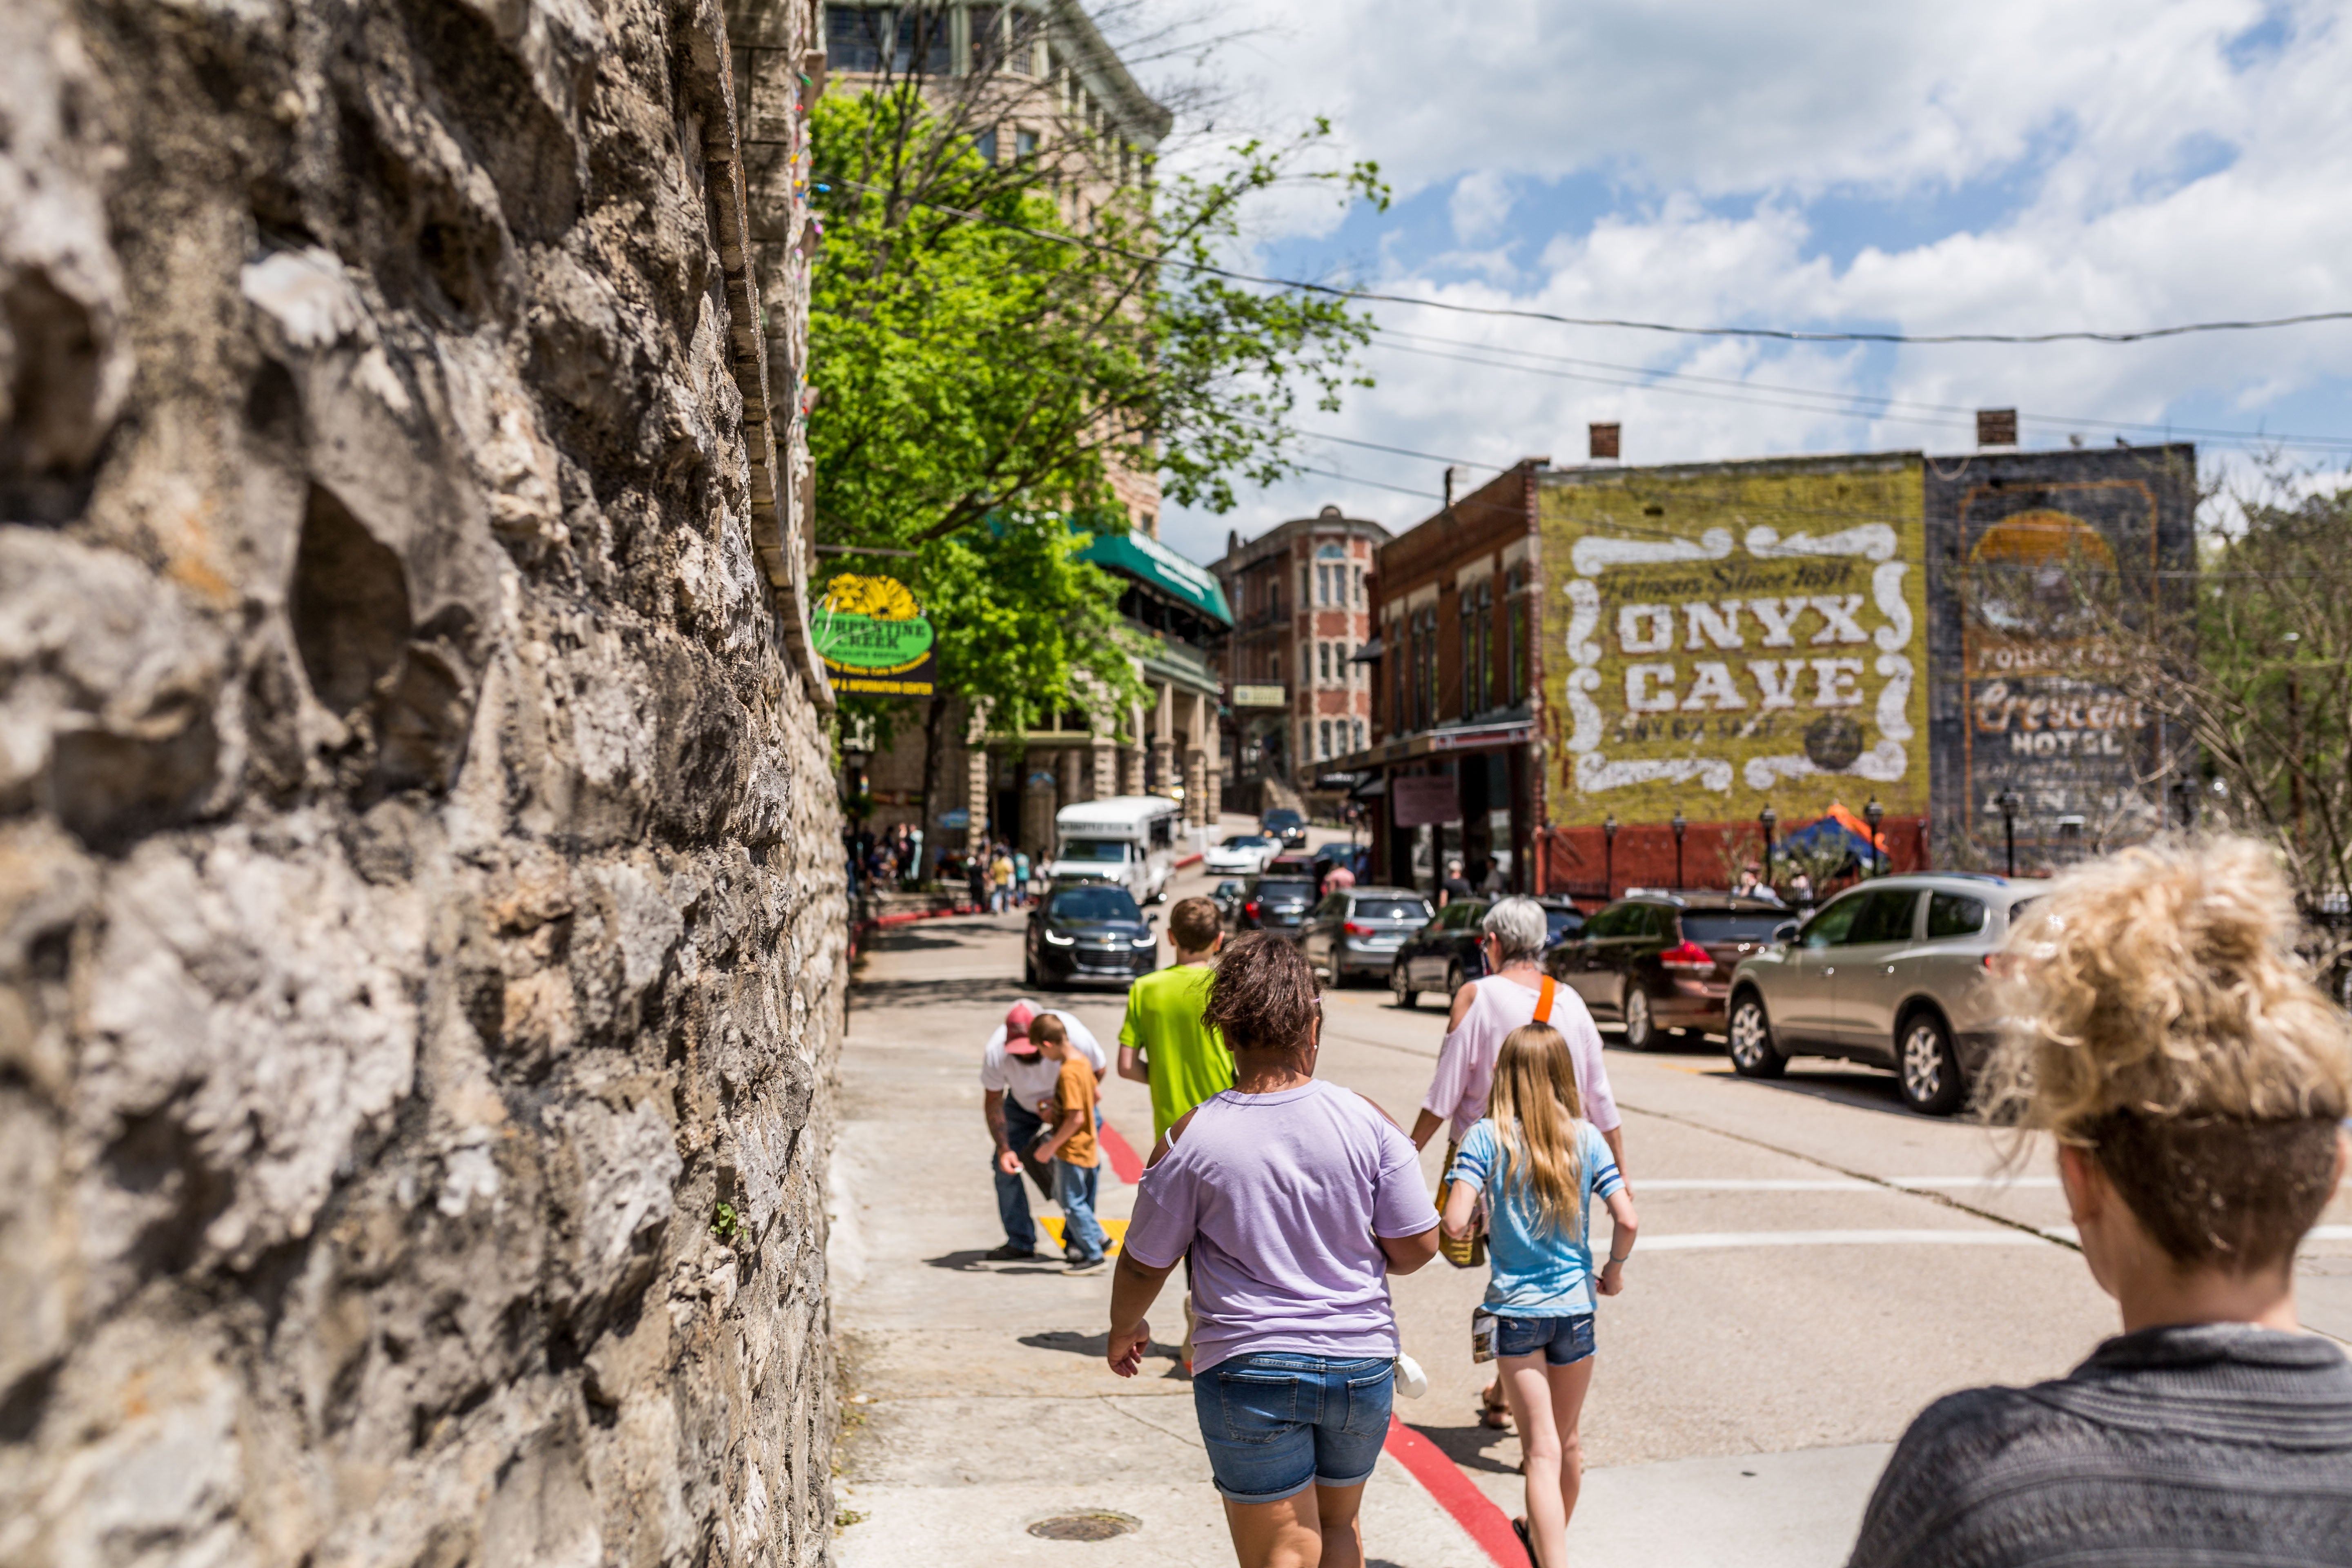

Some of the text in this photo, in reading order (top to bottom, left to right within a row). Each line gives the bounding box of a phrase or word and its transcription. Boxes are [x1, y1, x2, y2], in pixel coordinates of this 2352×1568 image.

[1618, 594, 1869, 653] ONYX
[1625, 657, 1865, 713] CAVE
[1974, 682, 2147, 733] Crescent
[2011, 731, 2124, 757] HOTEL
